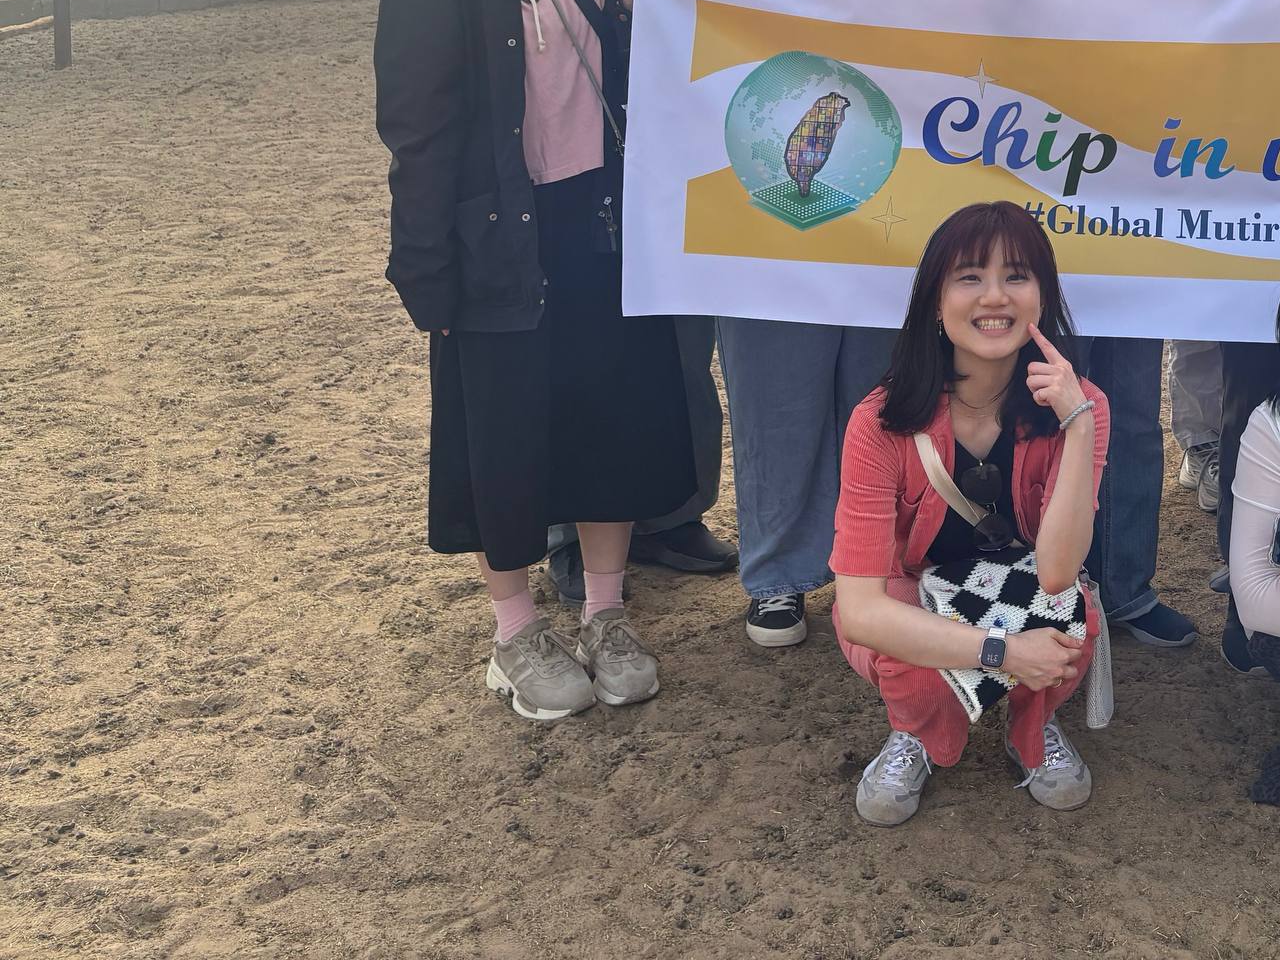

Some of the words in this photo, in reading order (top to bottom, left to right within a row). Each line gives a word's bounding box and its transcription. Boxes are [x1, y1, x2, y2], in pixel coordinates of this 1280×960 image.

[922, 96, 1118, 197] Chip
[1153, 118, 1235, 180] in
[1023, 201, 1164, 238] #Global
